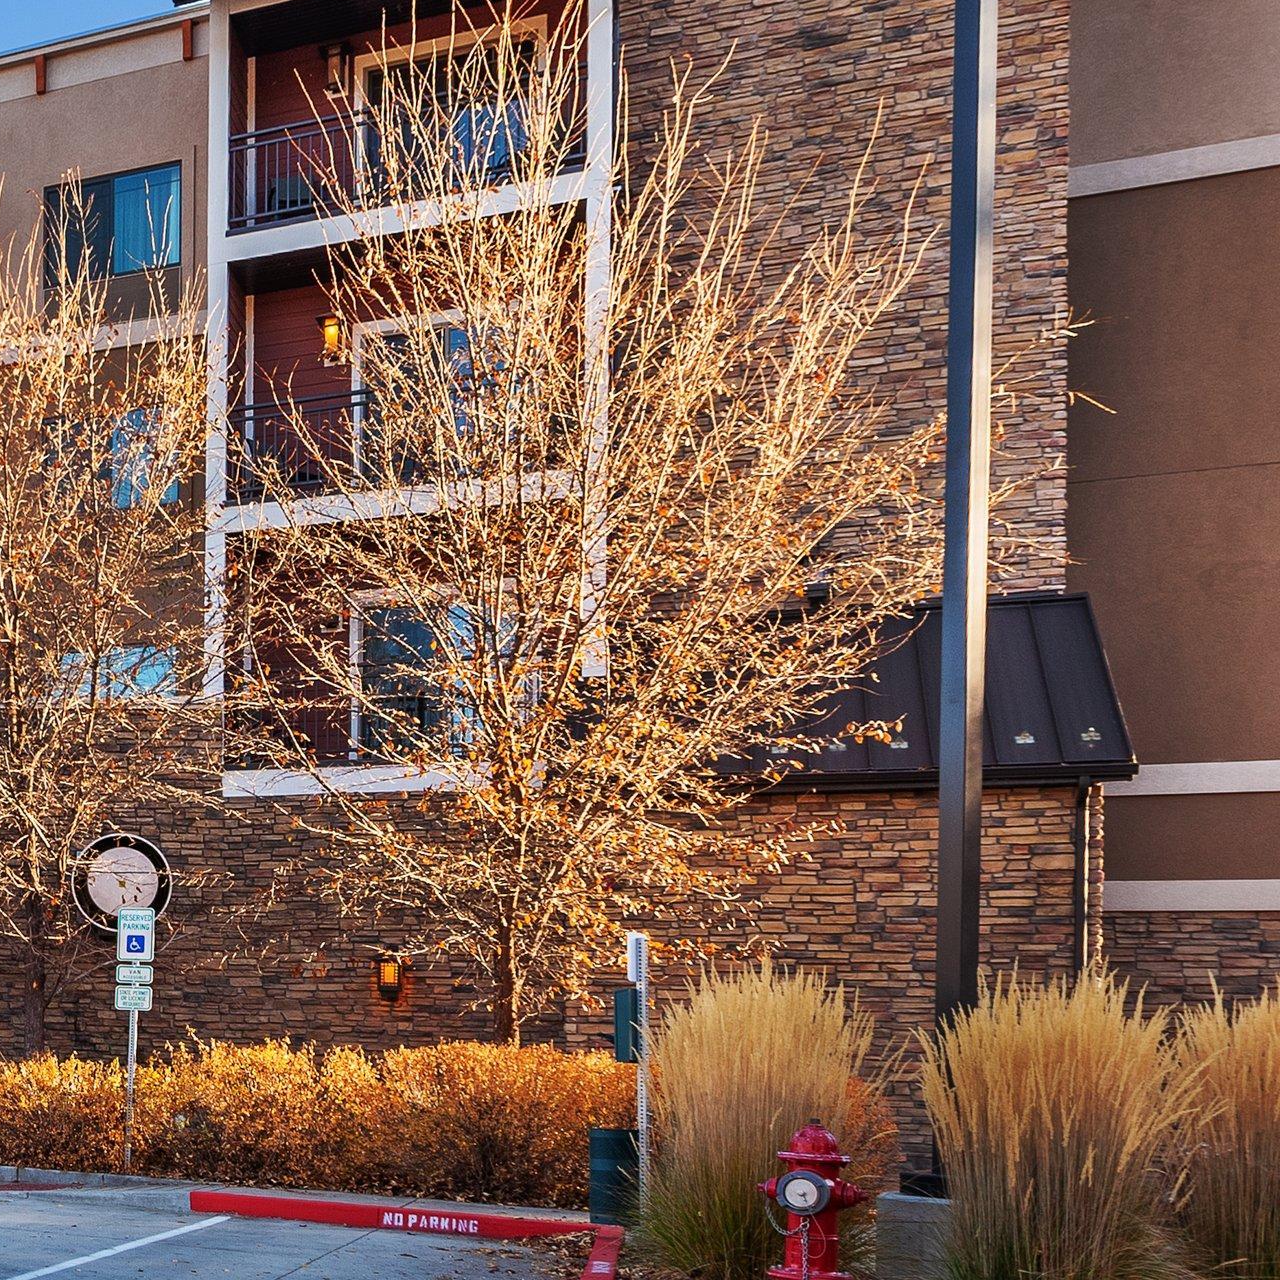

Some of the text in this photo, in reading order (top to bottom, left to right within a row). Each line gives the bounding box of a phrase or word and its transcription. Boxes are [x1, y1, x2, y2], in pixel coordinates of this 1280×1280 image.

[121, 914, 152, 922] RESERVED
[122, 923, 150, 931] PARKING
[383, 1212, 479, 1233] NO PARKING
